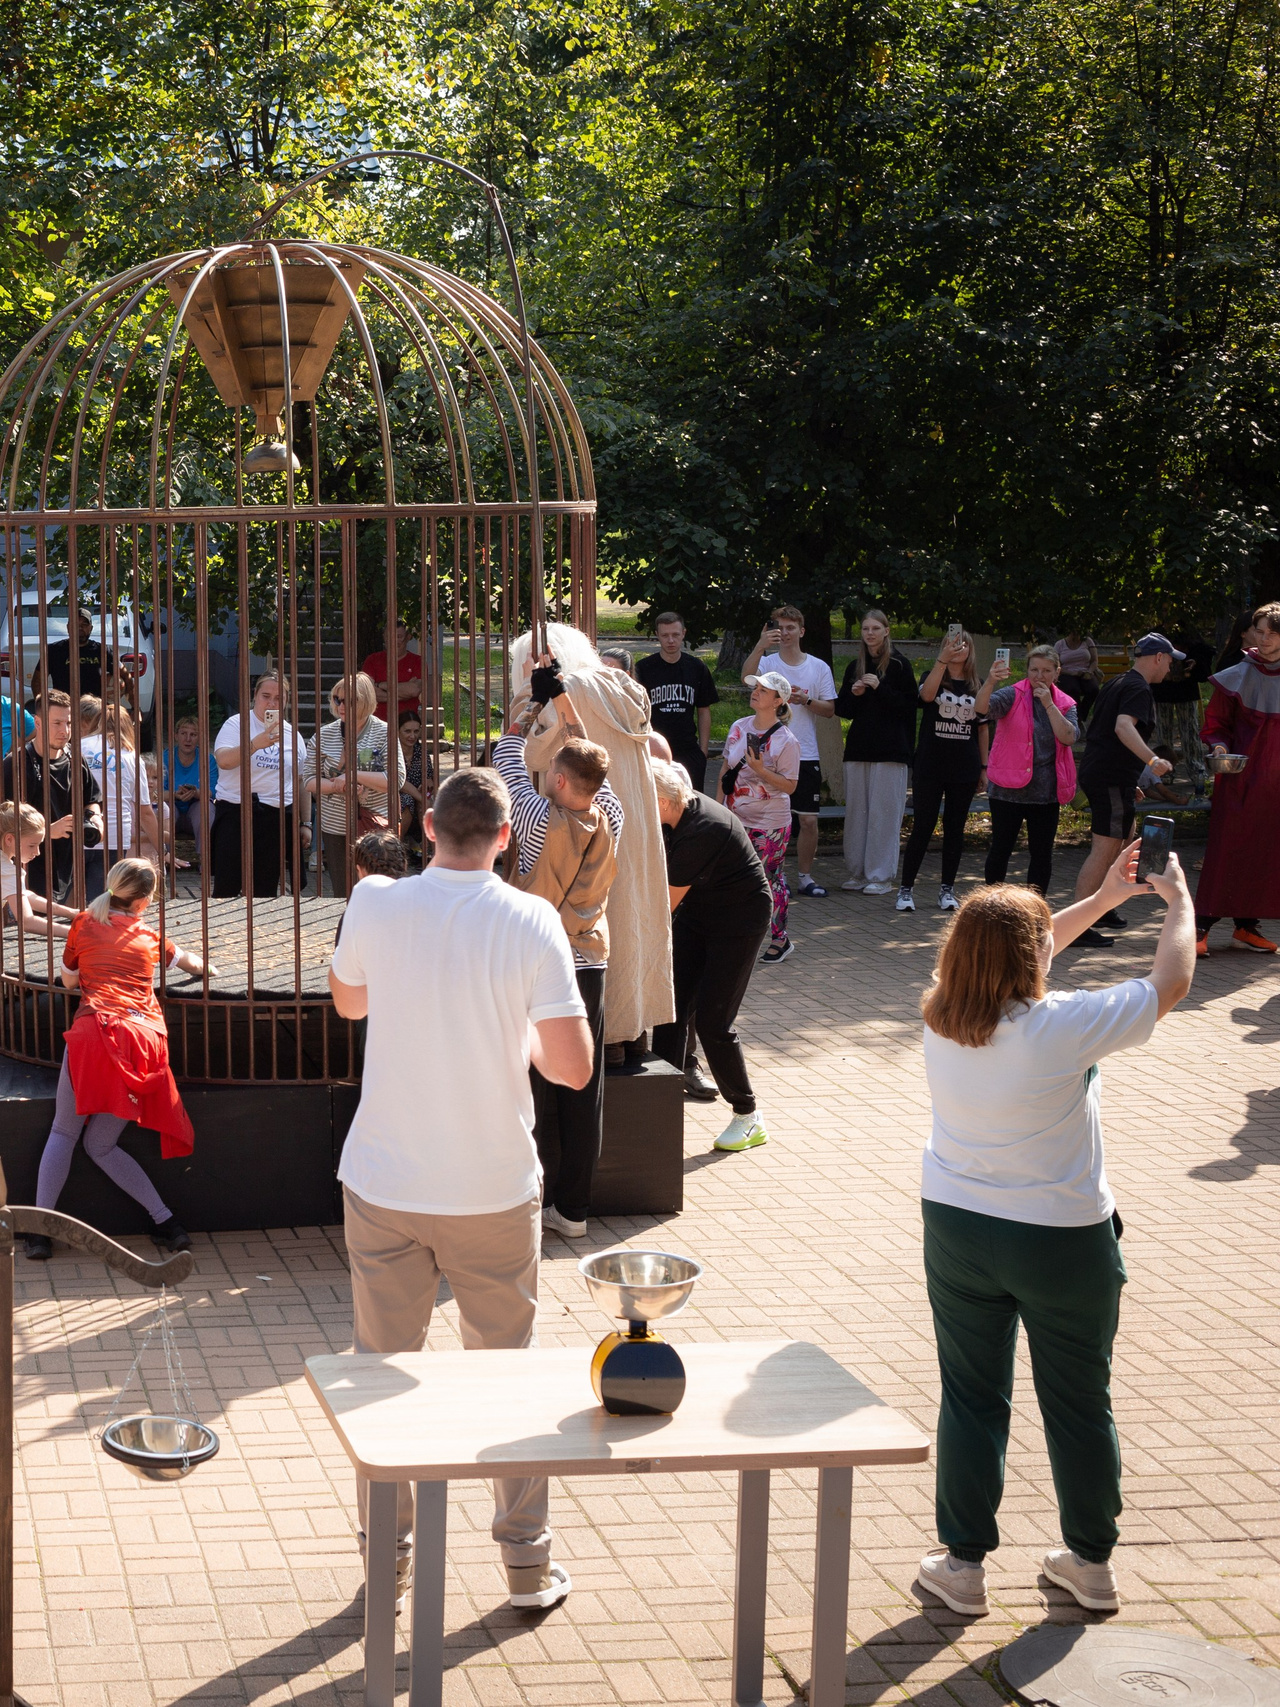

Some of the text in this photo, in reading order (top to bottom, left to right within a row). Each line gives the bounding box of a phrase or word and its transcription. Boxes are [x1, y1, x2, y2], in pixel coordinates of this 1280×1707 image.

[650, 684, 695, 706] BROOKLYN
[935, 721, 972, 735] WINNER
[257, 762, 280, 771] СТРЕЛ
